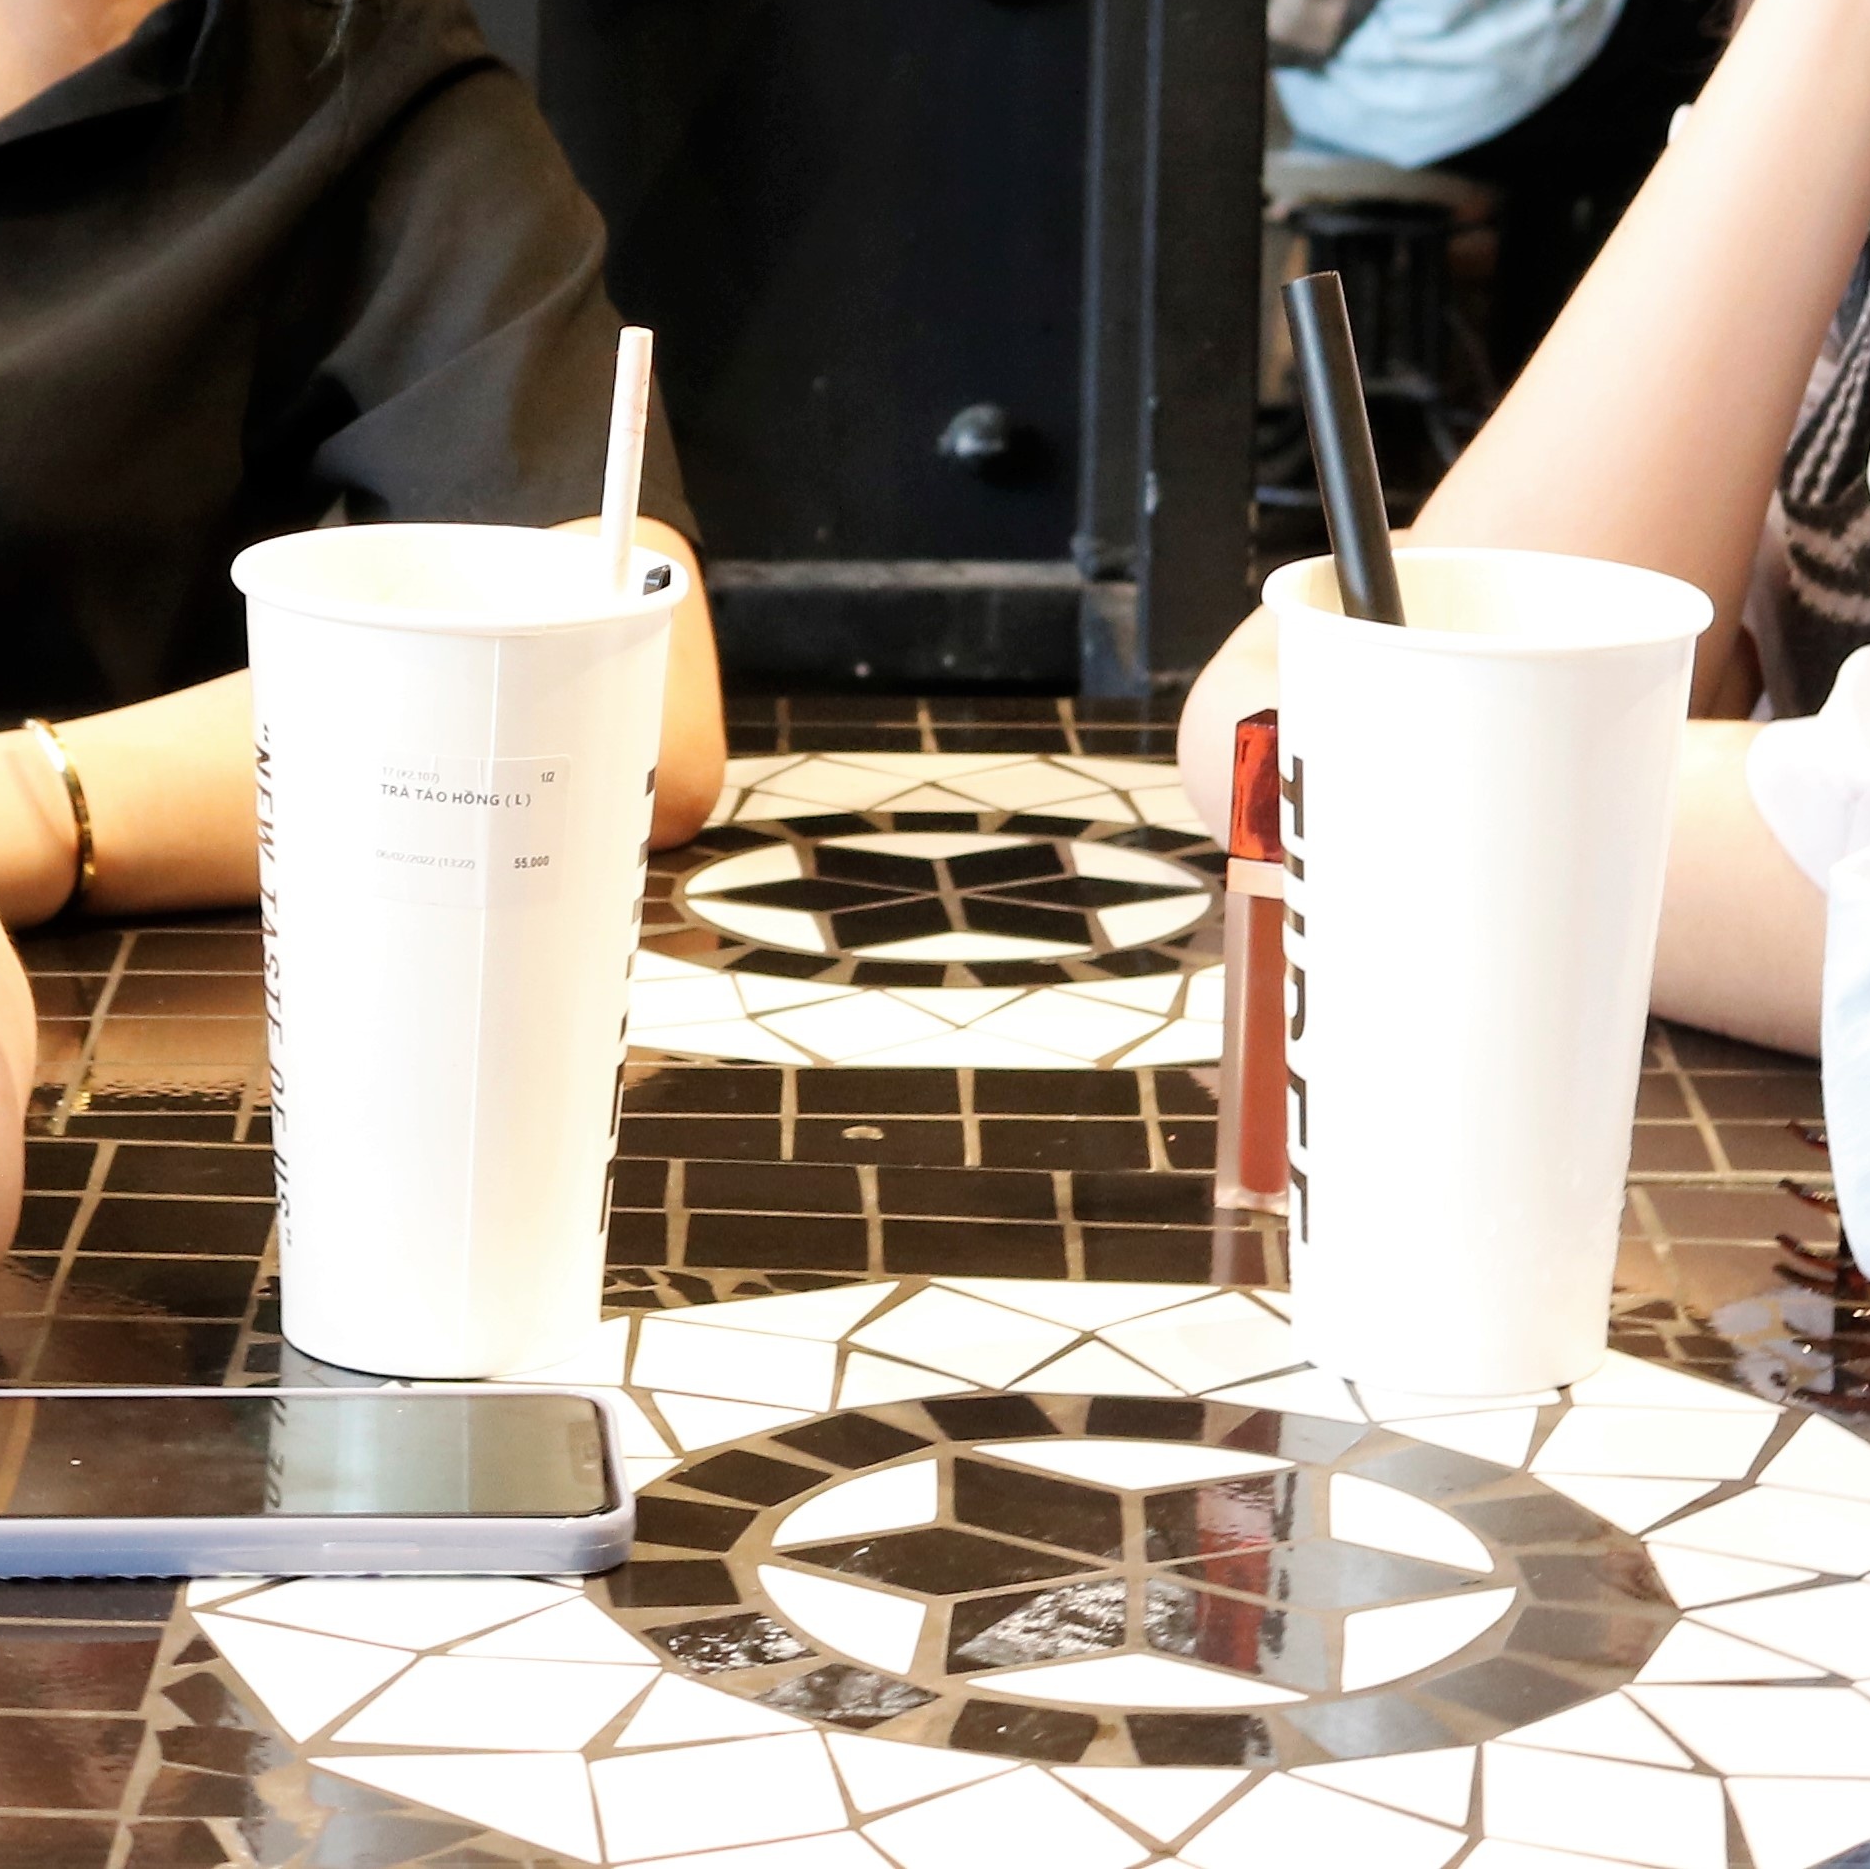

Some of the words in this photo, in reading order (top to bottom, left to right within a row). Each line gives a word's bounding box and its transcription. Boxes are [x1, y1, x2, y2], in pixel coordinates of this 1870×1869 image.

[380, 783, 410, 799] TRÀ
[415, 787, 447, 803] TÁO
[513, 854, 551, 870] 55.000
